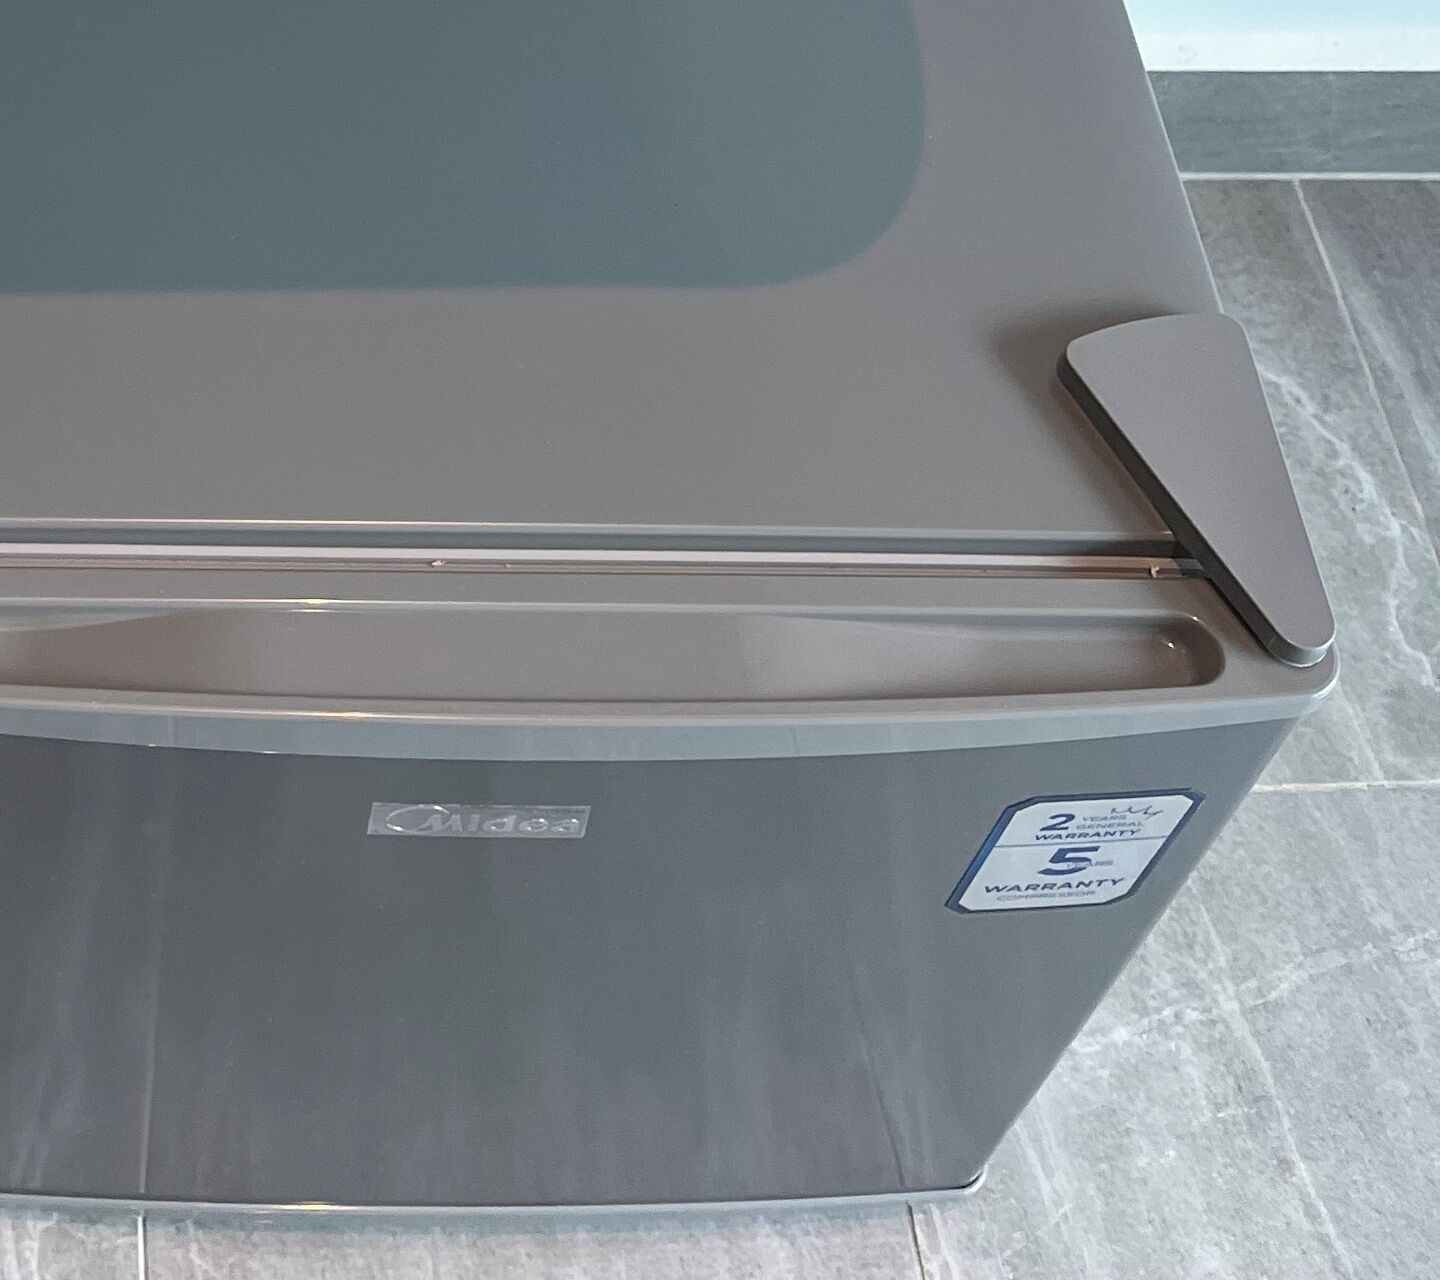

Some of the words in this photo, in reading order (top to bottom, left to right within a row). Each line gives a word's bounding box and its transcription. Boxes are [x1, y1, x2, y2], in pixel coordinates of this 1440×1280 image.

[398, 809, 580, 834] Midea
[1039, 813, 1076, 831] 2
[1035, 828, 1142, 841] WARRANTY
[1037, 845, 1101, 876] 5
[984, 877, 1125, 894] WARRANTY
